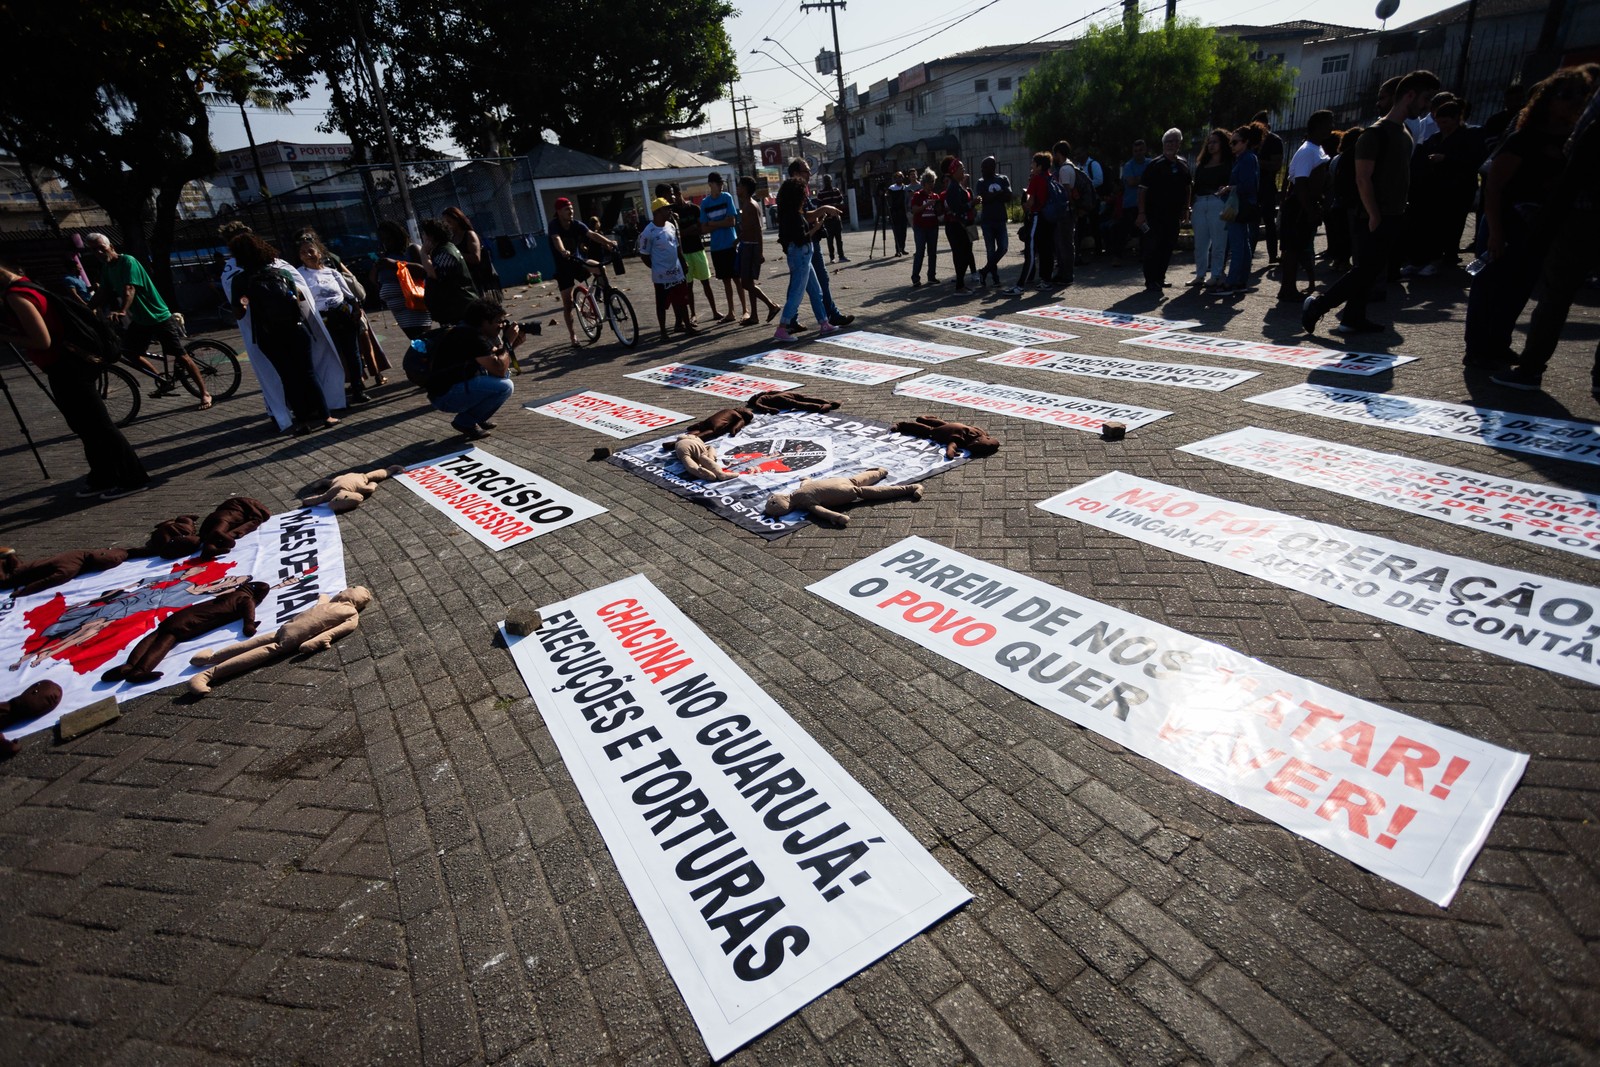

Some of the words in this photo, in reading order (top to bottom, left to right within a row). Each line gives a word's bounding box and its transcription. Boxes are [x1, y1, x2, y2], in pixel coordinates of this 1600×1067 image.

[300, 147, 335, 155] PORTO
[1159, 334, 1247, 348] PELO
[1252, 345, 1320, 356] FIM
[1323, 352, 1387, 364] DE
[1136, 364, 1239, 380] GENOCIDA
[918, 376, 968, 388] LUTO!
[961, 384, 1060, 405] QUEREMOS
[1056, 397, 1153, 421] JUSTIÇA!
[952, 393, 1021, 411] ABUSO
[1012, 405, 1048, 416] DE
[1041, 409, 1128, 429] PODE
[1304, 401, 1327, 409] E
[1453, 425, 1499, 437] DE
[833, 421, 889, 438] DE
[1503, 420, 1549, 432] DE
[1259, 440, 1342, 461] ESTÃO
[1348, 461, 1450, 486] SENDO
[1459, 485, 1600, 520] OPRIMI
[1314, 446, 1428, 472] NOSSAS
[439, 455, 574, 524] TARCÍSIO
[1250, 460, 1284, 471] DA
[1464, 515, 1514, 531] DA
[1284, 461, 1434, 501] PRECISAM
[1441, 499, 1492, 514] DE
[1324, 462, 1486, 505] VIOLÊNCIA
[1498, 503, 1600, 531] POLI
[280, 509, 319, 552] MÃES
[731, 502, 786, 531] ESTADO
[1112, 487, 1199, 518] NÃO
[1194, 509, 1278, 541] FOI
[278, 549, 319, 580] DE
[1065, 496, 1109, 514] FOI
[1105, 507, 1228, 553] VINGANÇA
[1252, 553, 1382, 598] ACERTO
[1383, 589, 1442, 616] DE
[1446, 608, 1600, 667] CONTA
[534, 609, 645, 734] EXECUÇÕES
[848, 576, 886, 599] O
[876, 589, 997, 648] POVO
[994, 641, 1150, 723] QUER
[881, 549, 1018, 611] PAREM
[1005, 594, 1083, 637] DE
[1071, 619, 1194, 681] NOS
[1216, 666, 1471, 801] ATAR!
[596, 598, 694, 685] CHACINA
[660, 672, 728, 719] NO
[696, 713, 886, 903] GUARUJÁ:
[602, 725, 663, 761] E
[621, 747, 811, 982] TORTURAS
